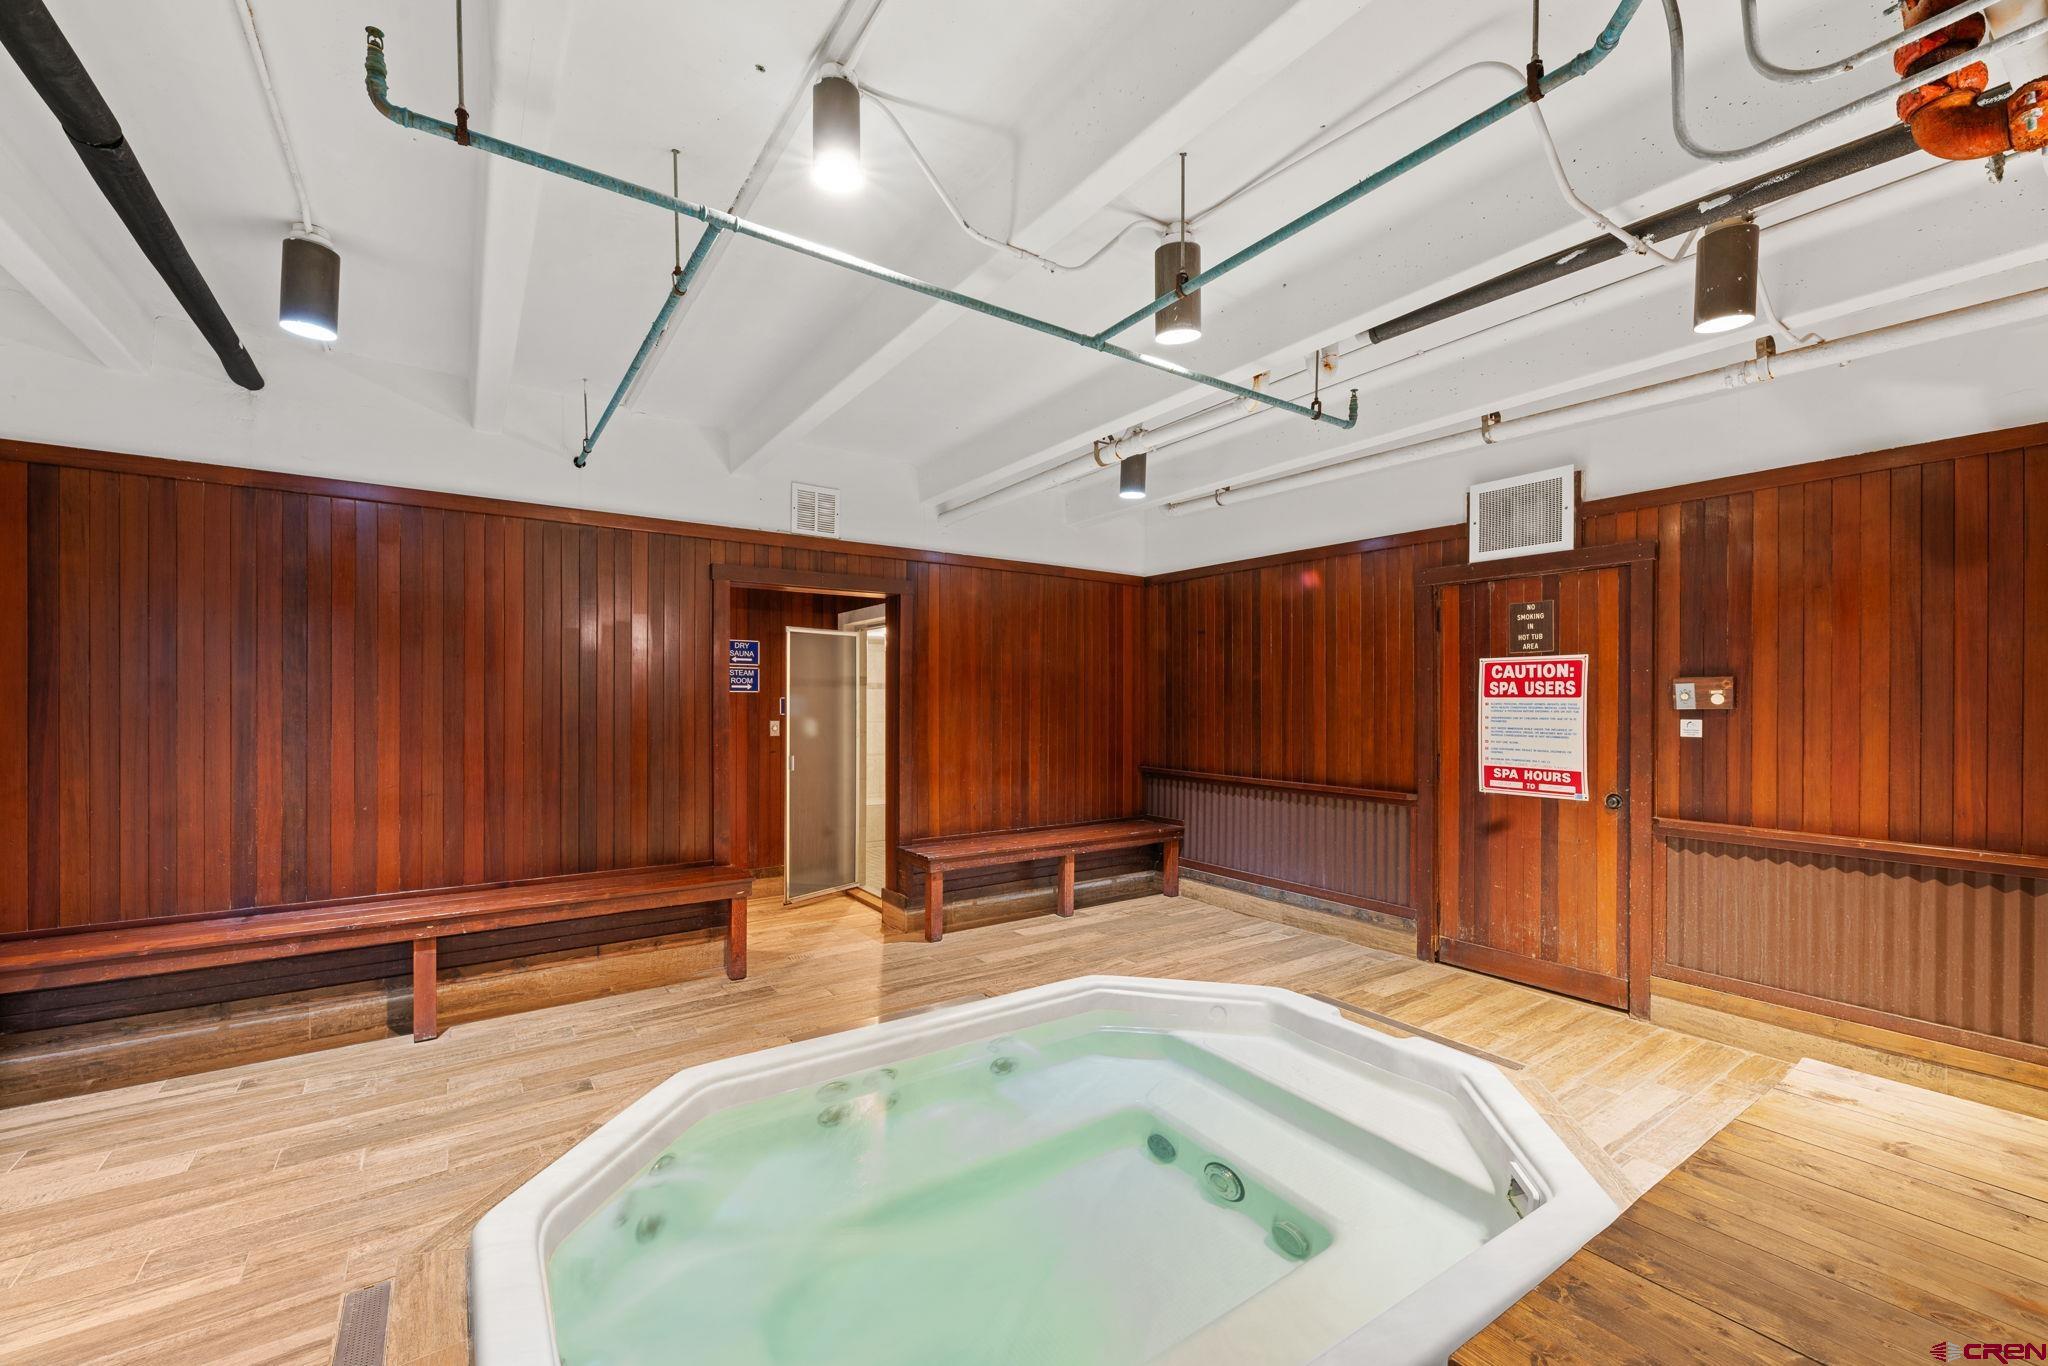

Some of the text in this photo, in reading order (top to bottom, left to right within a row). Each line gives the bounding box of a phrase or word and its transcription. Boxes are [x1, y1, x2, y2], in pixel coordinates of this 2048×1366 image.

[1526, 603, 1536, 611] NO
[1516, 612, 1545, 621] SMOKING
[1517, 633, 1530, 641] HOT
[1522, 642, 1539, 650] AREA
[1491, 663, 1575, 679] CAUTION:
[1489, 680, 1576, 696] SPA USERS
[1493, 767, 1519, 779] SPA
[1523, 769, 1571, 783] HOURS
